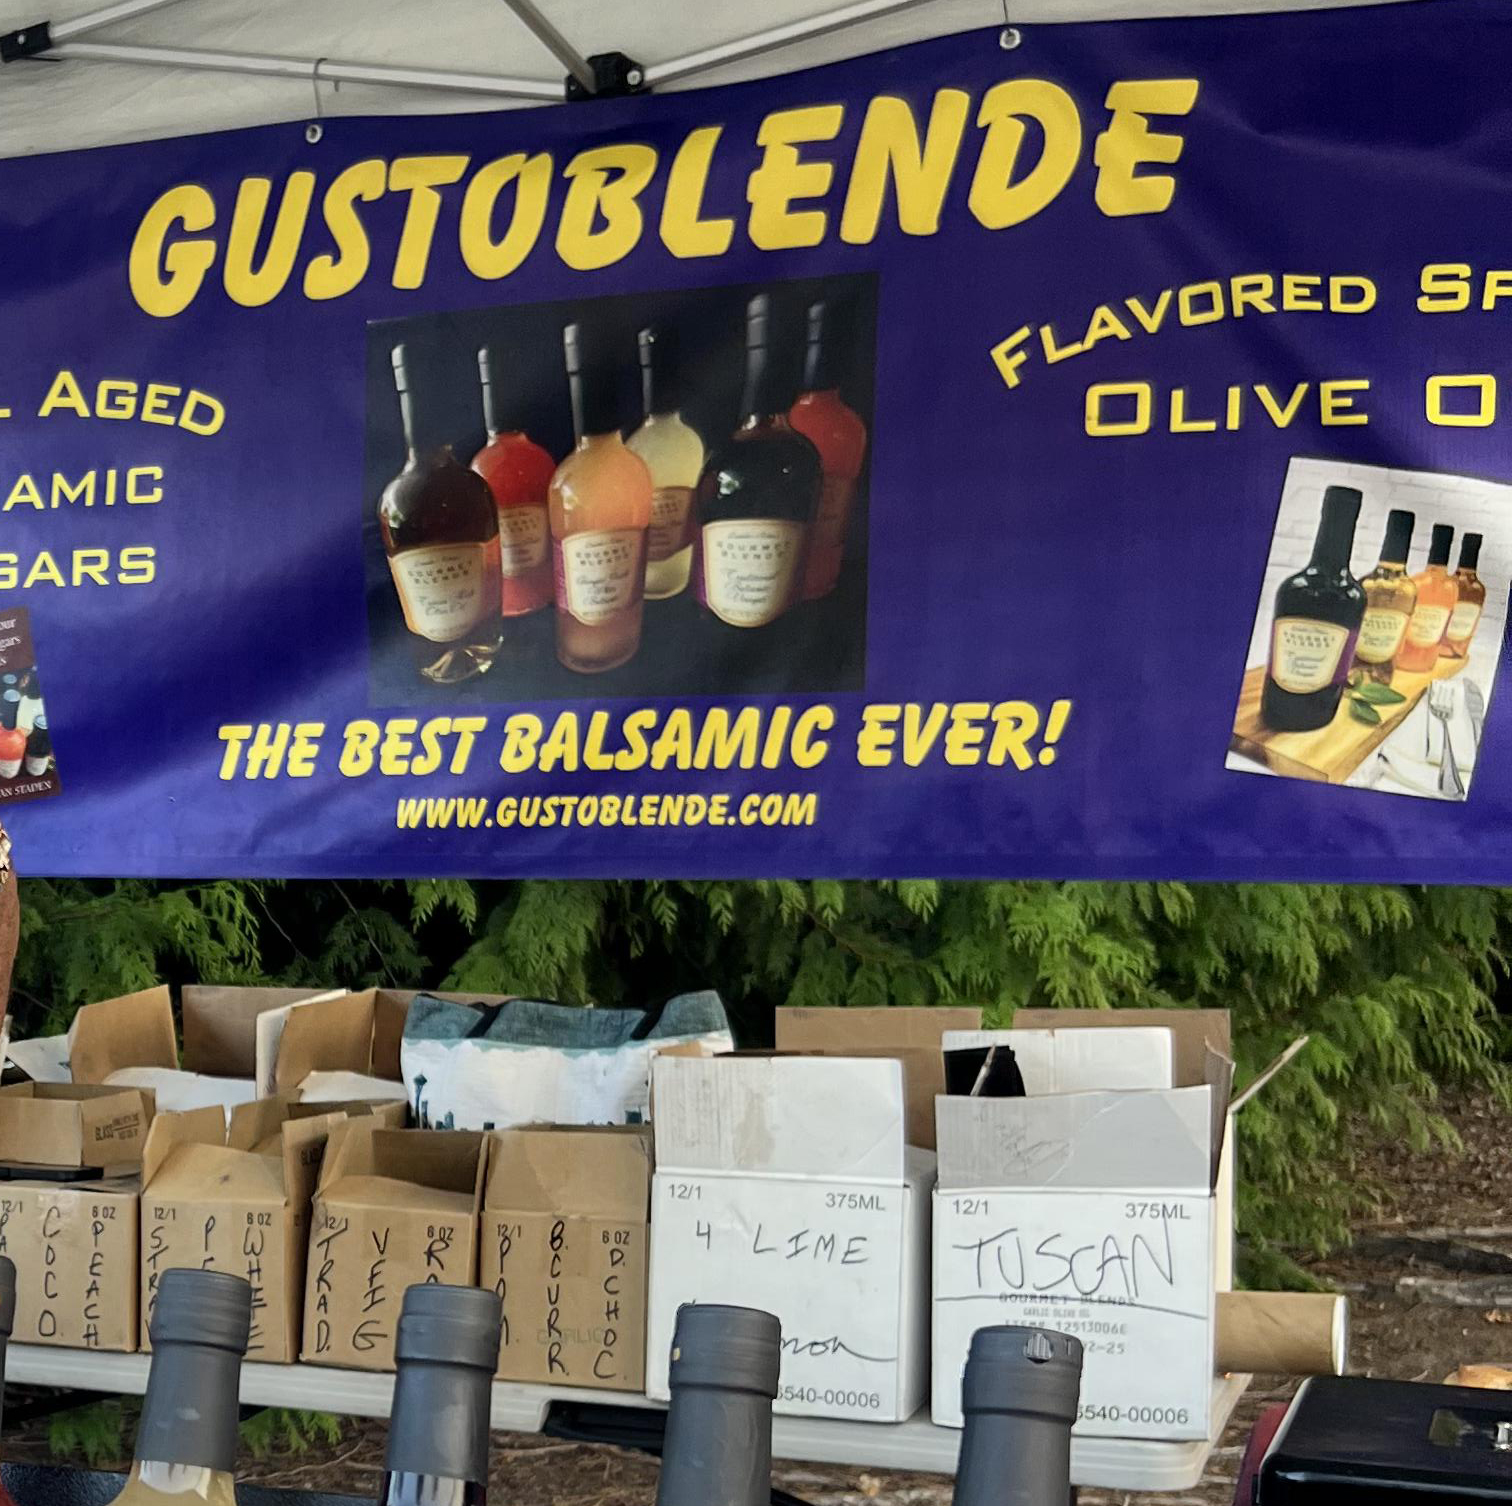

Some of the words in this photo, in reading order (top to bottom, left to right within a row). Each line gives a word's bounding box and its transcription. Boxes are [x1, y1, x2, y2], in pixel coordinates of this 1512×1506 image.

[129, 78, 1199, 317] GUSTOBLENDE
[990, 273, 1377, 388] FLAVORED
[39, 371, 226, 437] AGED
[1085, 380, 1370, 436] OLIVE
[218, 724, 323, 781] THE
[340, 717, 484, 776] BEST
[500, 706, 832, 774] BALSAMIC
[858, 700, 1071, 770] EVER!
[397, 794, 816, 828] WWW.GUSTOBLENDE.COM
[153, 1206, 176, 1221] 12/1
[668, 1184, 702, 1200] 12/1
[825, 1192, 886, 1211] 375ML
[952, 1199, 989, 1215] 12/1
[1125, 1202, 1190, 1220] 375ML
[753, 1223, 869, 1264] LIME
[952, 1210, 1173, 1297] TUSCAN
